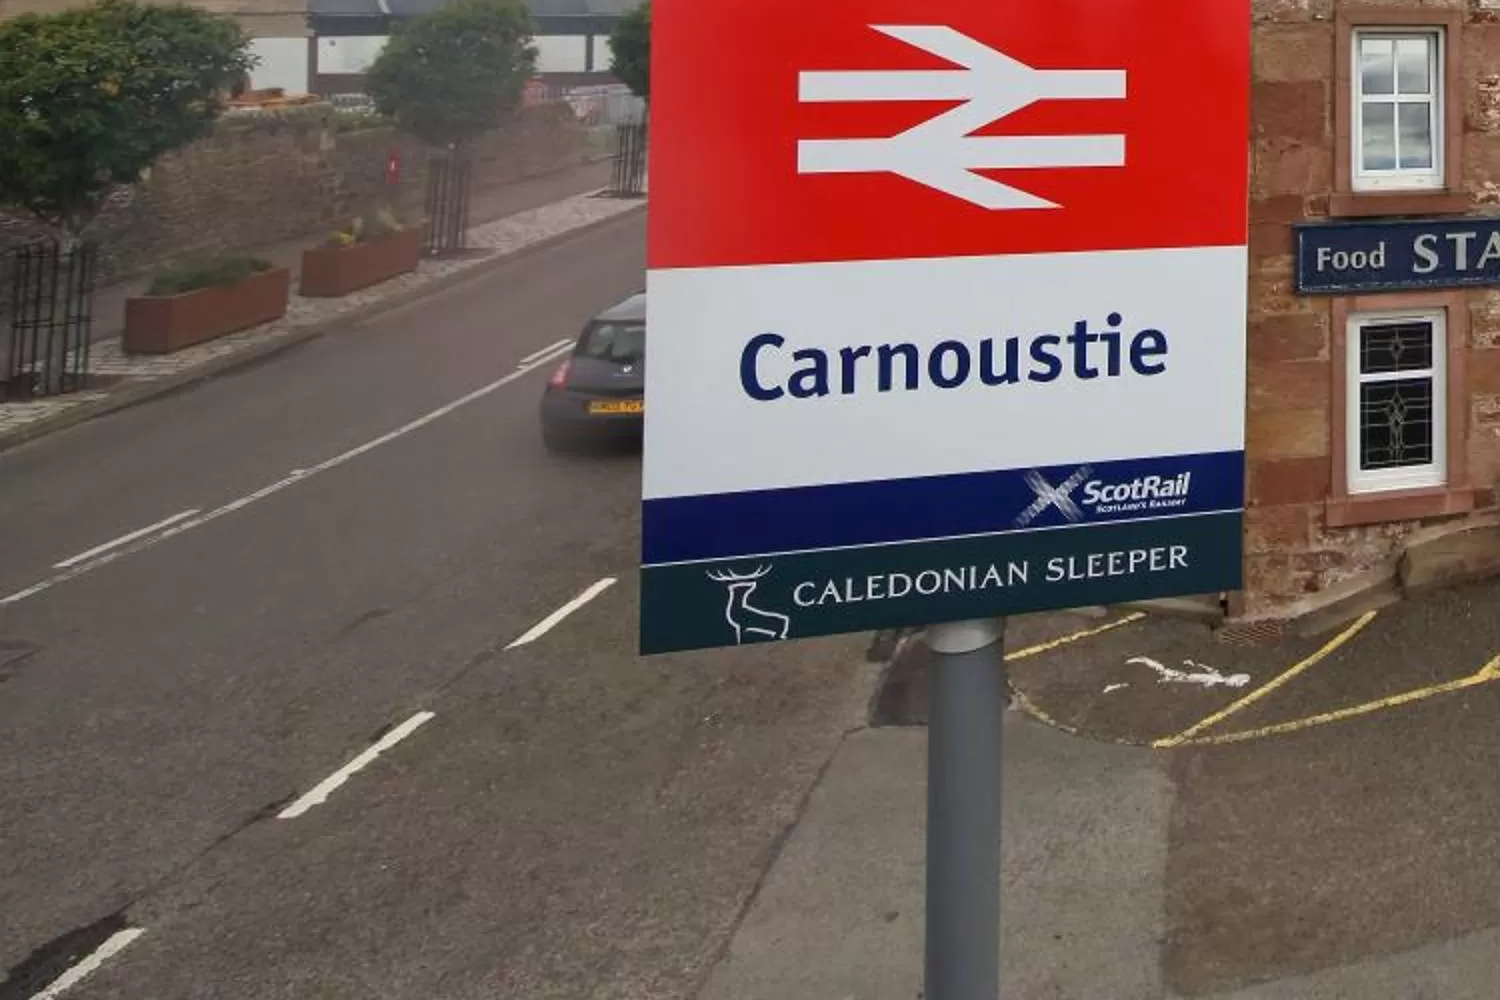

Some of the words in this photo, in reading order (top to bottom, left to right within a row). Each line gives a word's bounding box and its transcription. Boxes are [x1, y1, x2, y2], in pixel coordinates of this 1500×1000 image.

[1316, 241, 1386, 272] Food
[738, 311, 1169, 402] Carnoustie
[1081, 471, 1191, 504] ScotRail
[793, 560, 1029, 607] CALEDONIAN
[1044, 544, 1189, 583] SLEEPER
